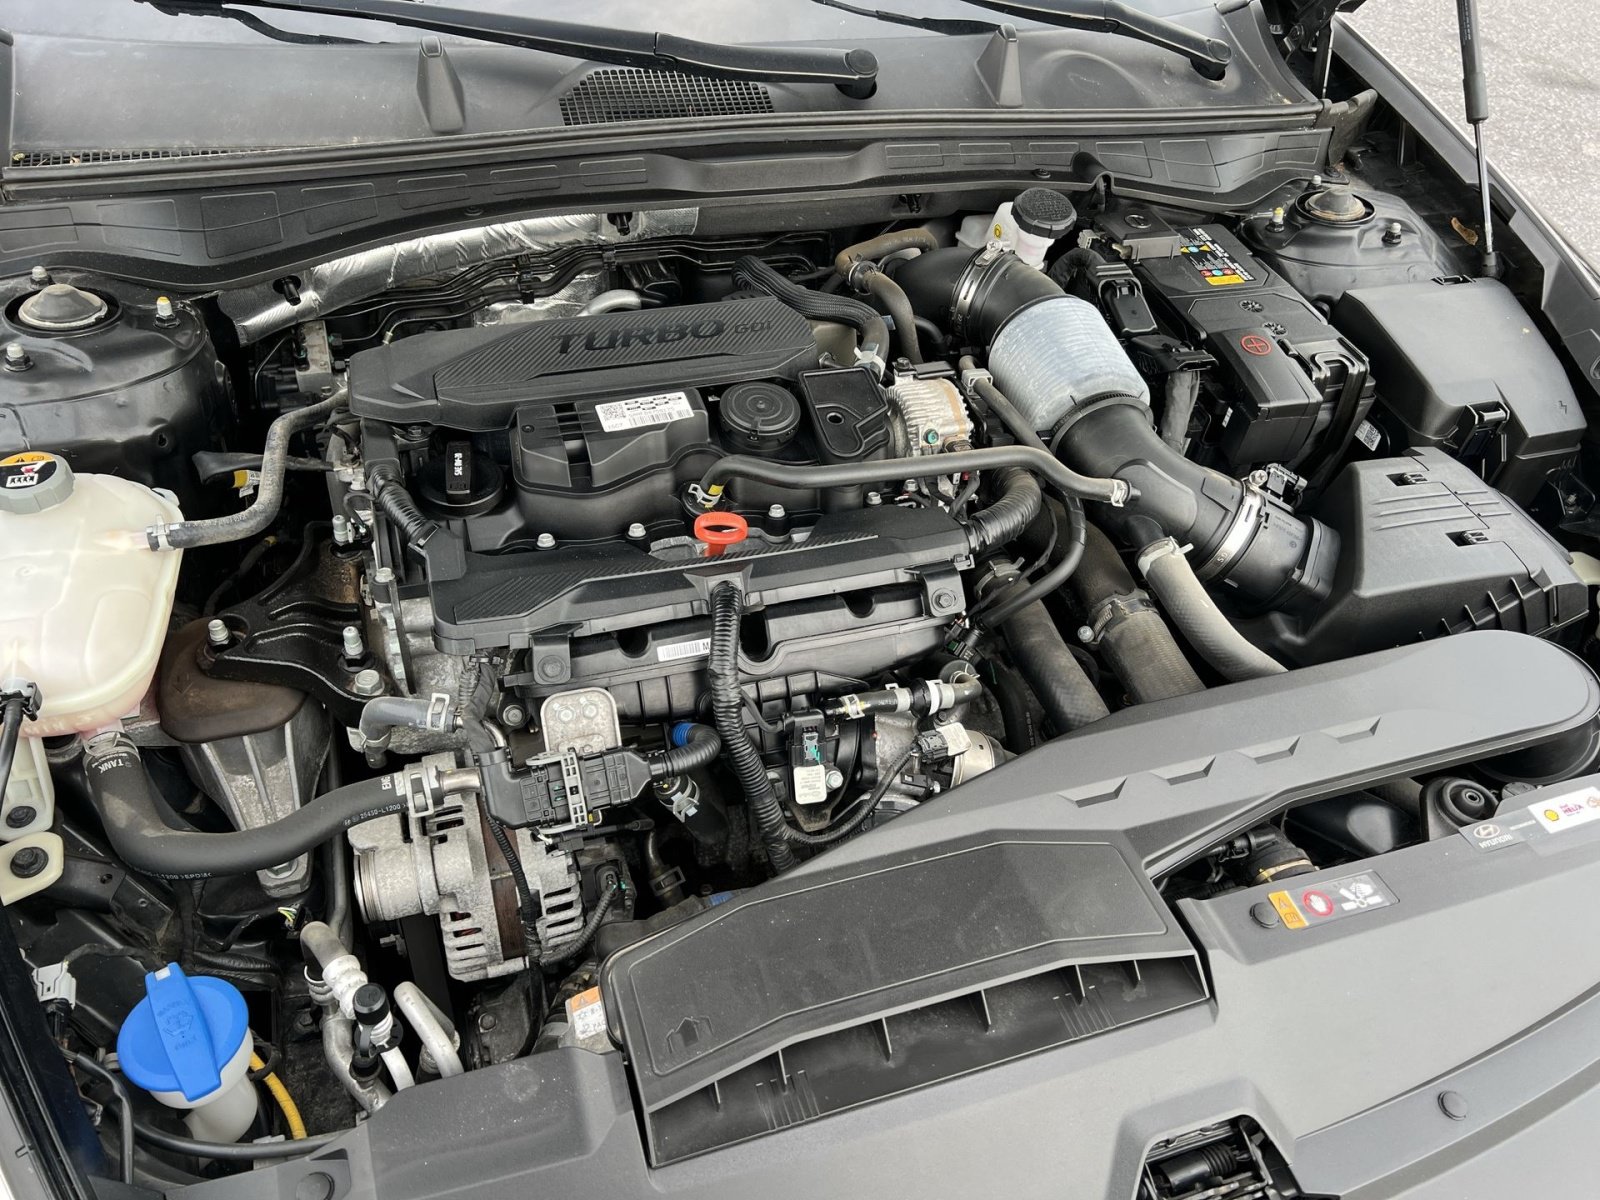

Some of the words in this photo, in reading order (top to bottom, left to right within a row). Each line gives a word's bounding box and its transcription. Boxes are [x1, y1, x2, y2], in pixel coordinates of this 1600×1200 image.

[551, 319, 725, 354] TURBO
[98, 758, 124, 774] TANK
[1478, 833, 1513, 849] HYUNDAI
